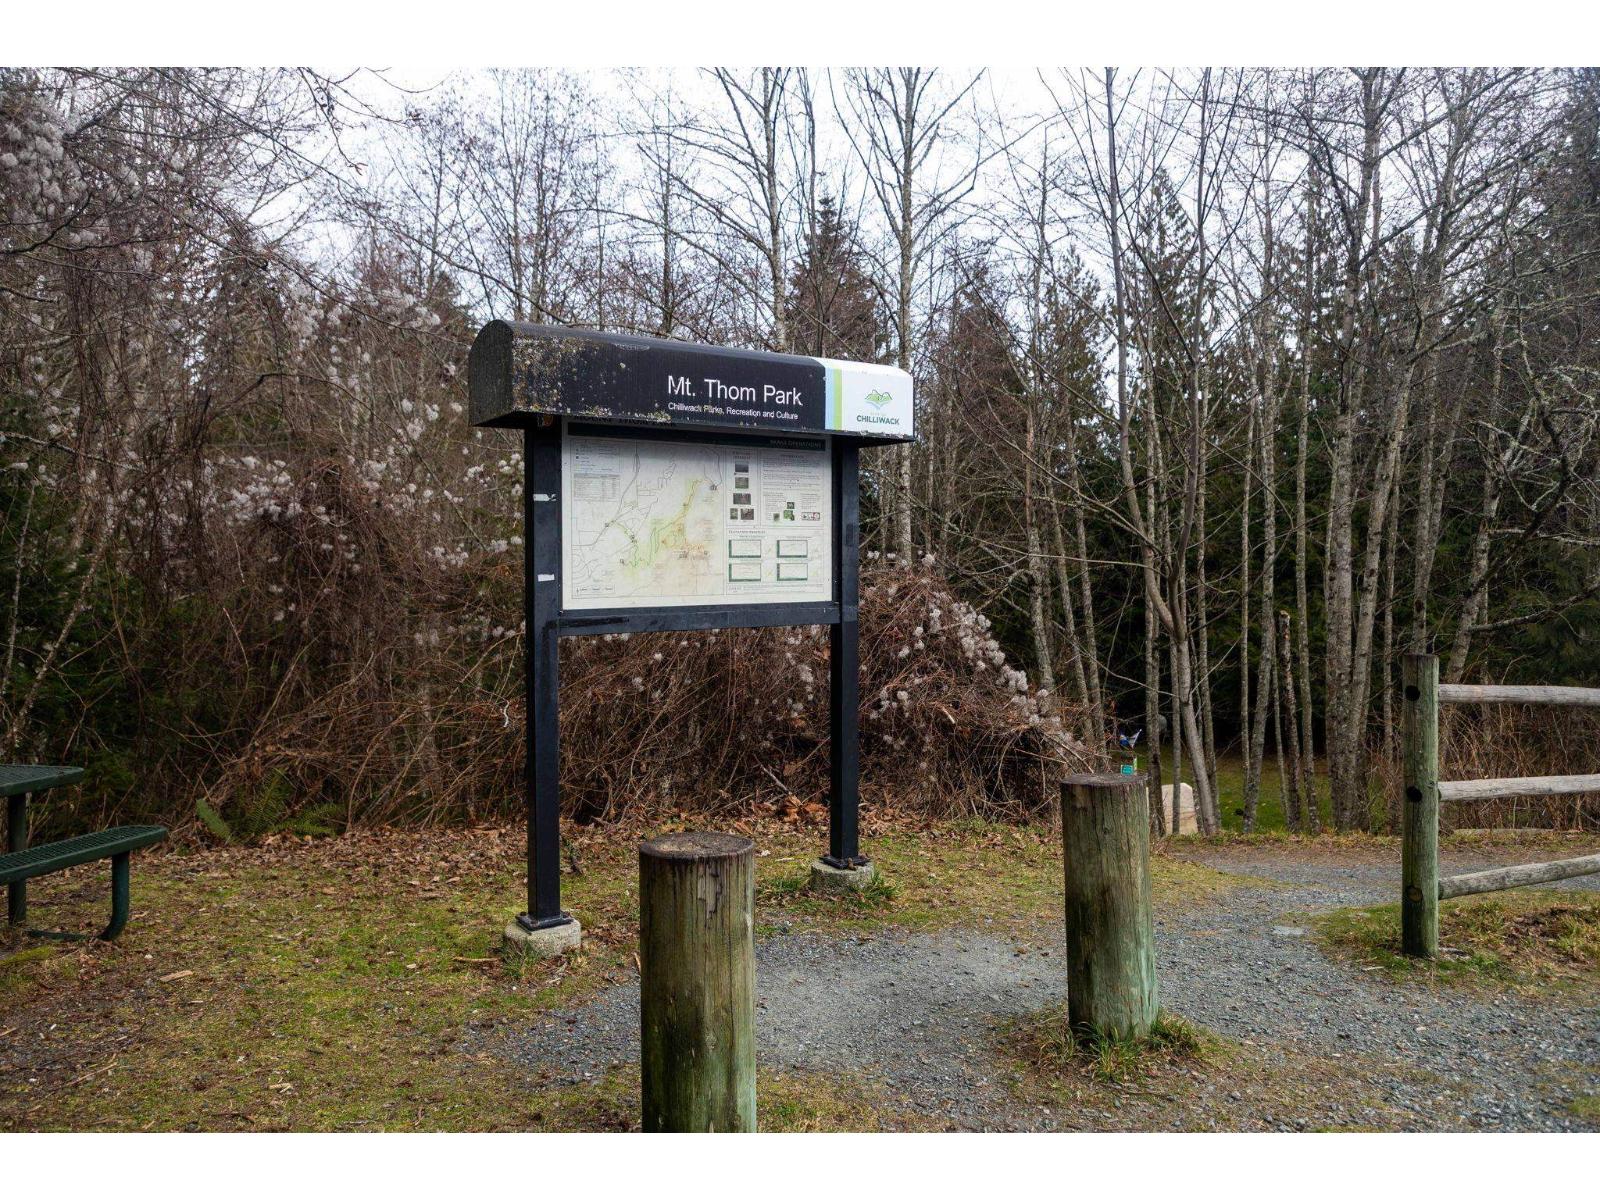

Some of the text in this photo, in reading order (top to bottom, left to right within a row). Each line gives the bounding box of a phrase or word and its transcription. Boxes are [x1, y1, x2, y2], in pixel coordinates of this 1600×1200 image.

[668, 375, 803, 406] Mt. Thom Park
[668, 402, 701, 413] Chilliwack
[726, 406, 760, 417] Recreation
[762, 410, 775, 418] and
[776, 411, 798, 420] Culture
[856, 415, 900, 425] CHILLIWACK
